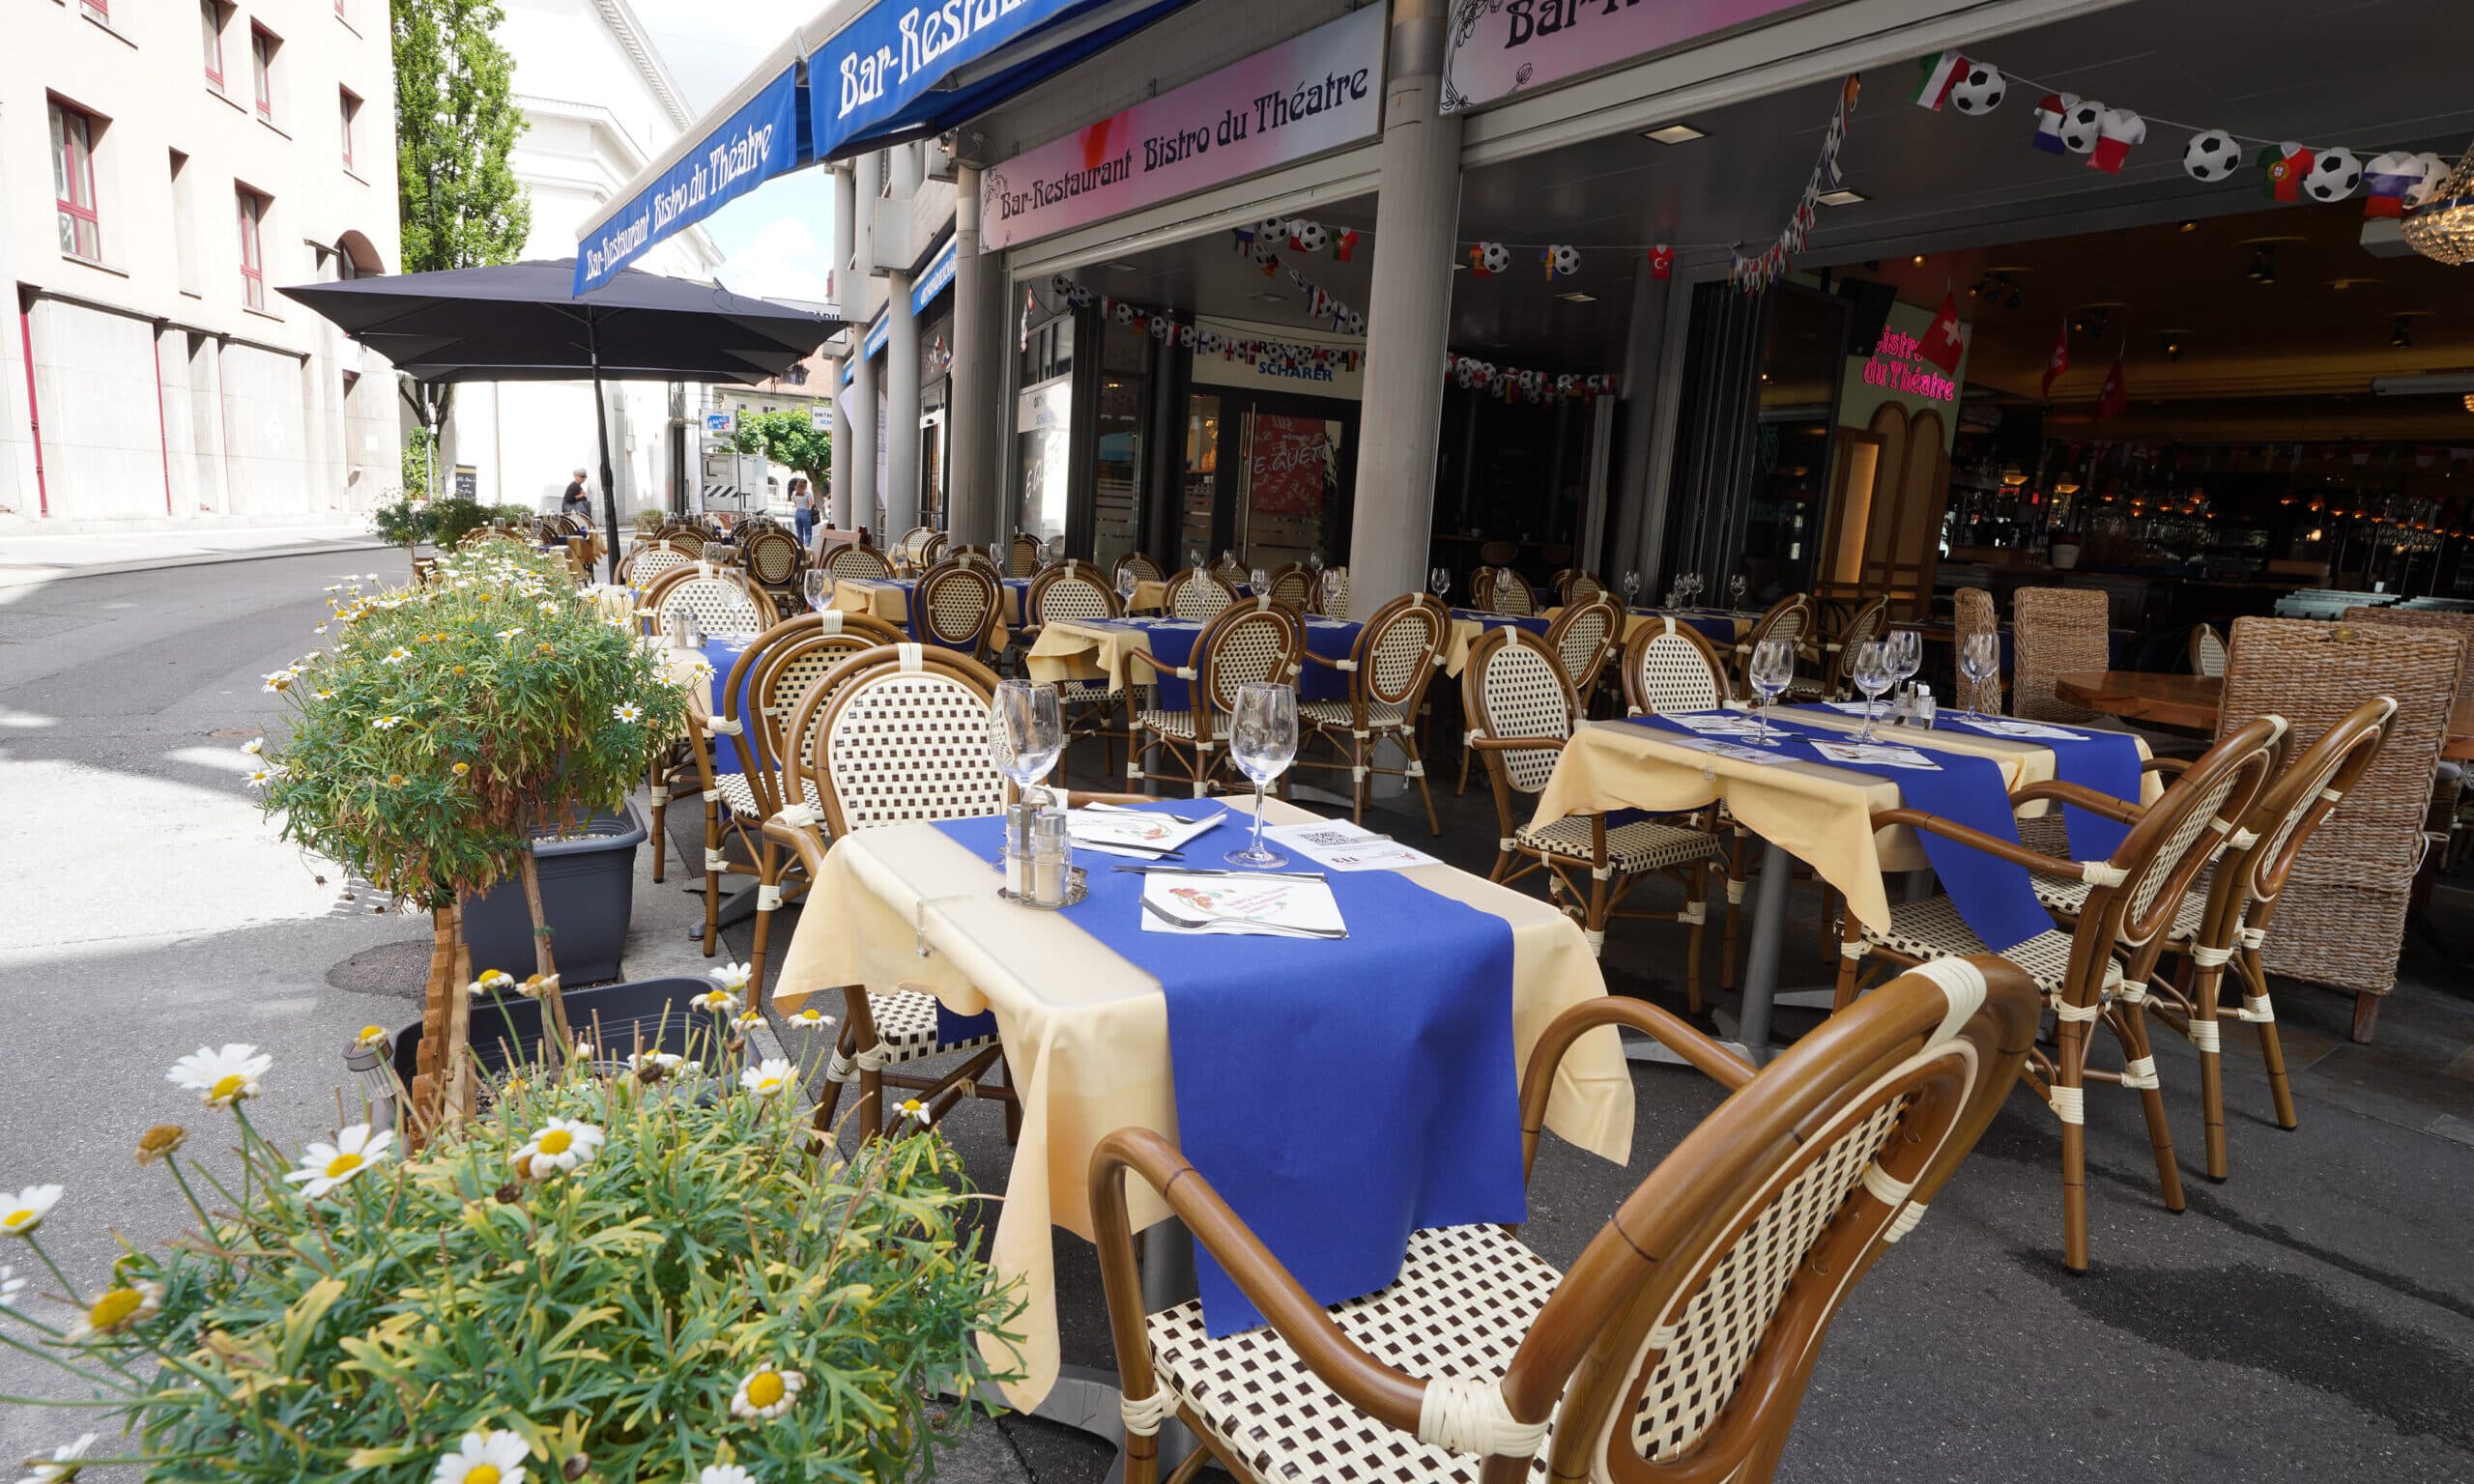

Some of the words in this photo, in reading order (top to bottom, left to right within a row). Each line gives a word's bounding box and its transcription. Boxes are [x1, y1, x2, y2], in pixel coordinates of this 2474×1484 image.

[838, 0, 1026, 119] Bar-Resta
[586, 204, 650, 282] Bar-Restaurant
[653, 183, 688, 234] Bistro
[688, 163, 707, 208] du
[709, 123, 773, 196] Théatre
[1001, 150, 1133, 221] Bar-Restaurant
[1143, 126, 1210, 173] Bistro
[1217, 109, 1247, 148] du
[1253, 68, 1369, 134] Théatre
[1862, 356, 1887, 386] du
[1889, 360, 1956, 402] Théatre
[1876, 325, 1924, 362] istr
